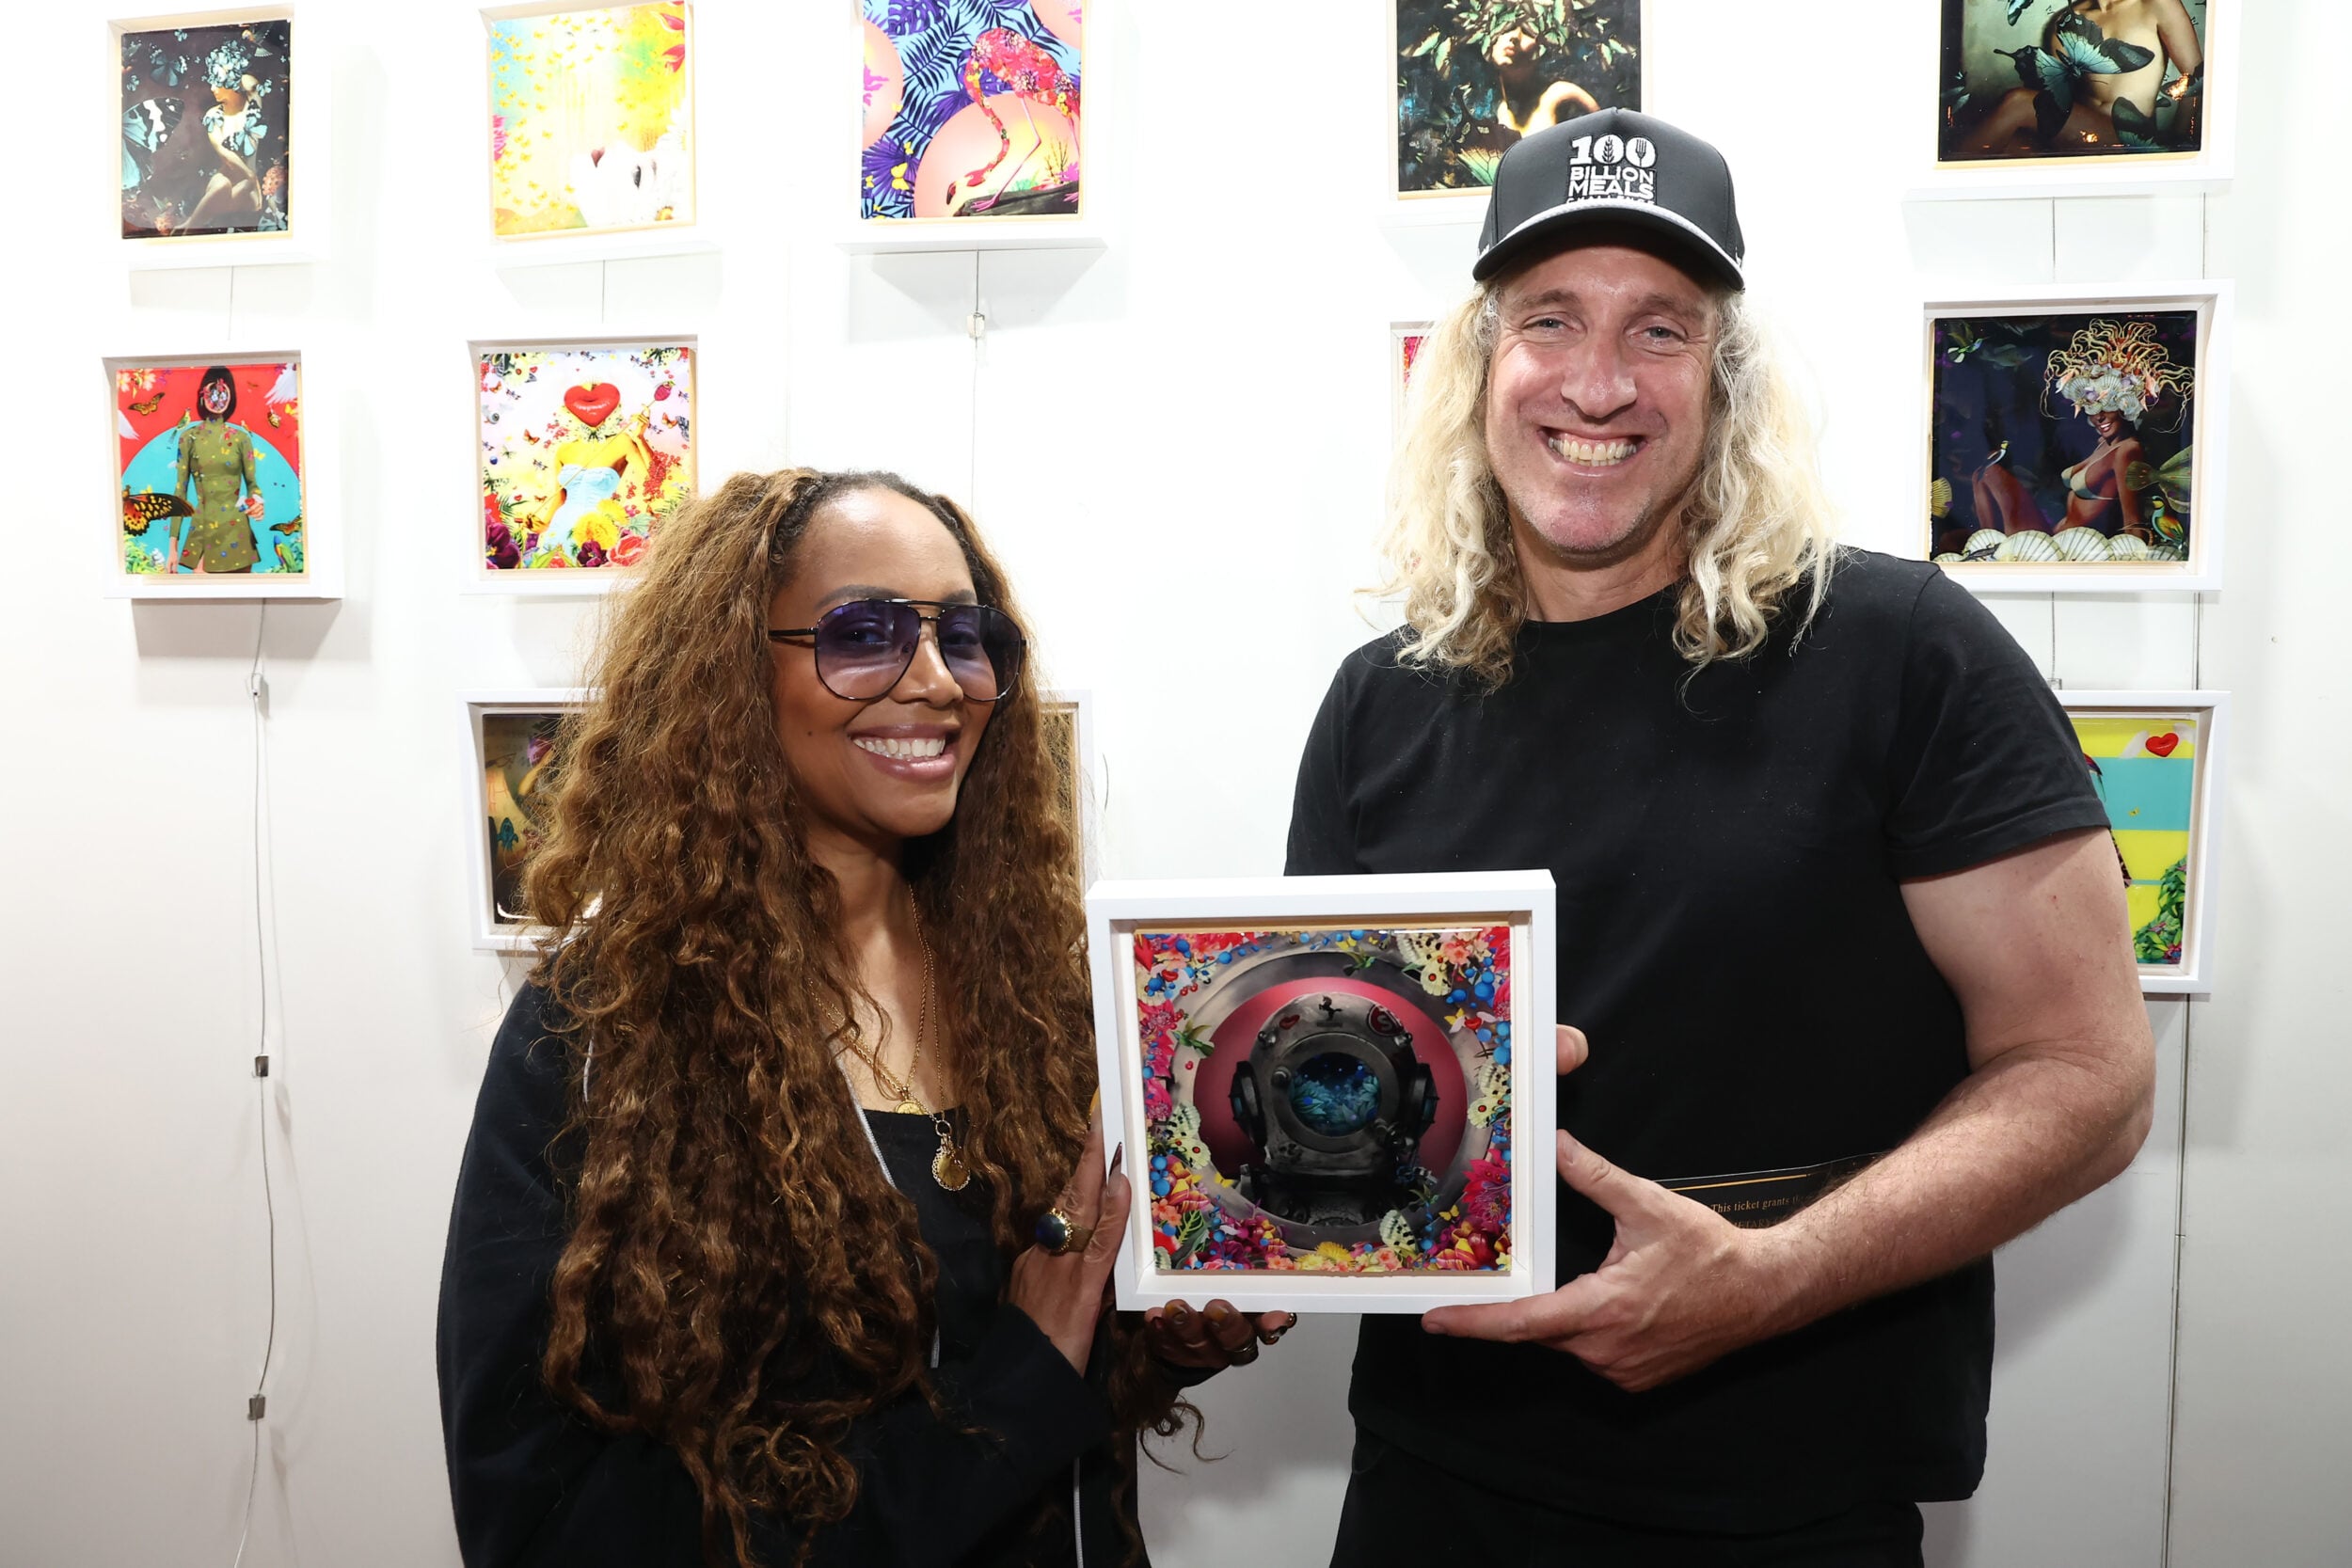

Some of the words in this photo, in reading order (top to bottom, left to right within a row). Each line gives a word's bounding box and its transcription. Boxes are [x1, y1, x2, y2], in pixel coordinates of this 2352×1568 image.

[1569, 134, 1657, 168] 100
[1570, 166, 1654, 184] BILLION
[1567, 179, 1655, 200] MEALS
[1710, 1203, 1732, 1212] This
[1734, 1199, 1759, 1212] ticket
[1762, 1196, 1789, 1210] grants
